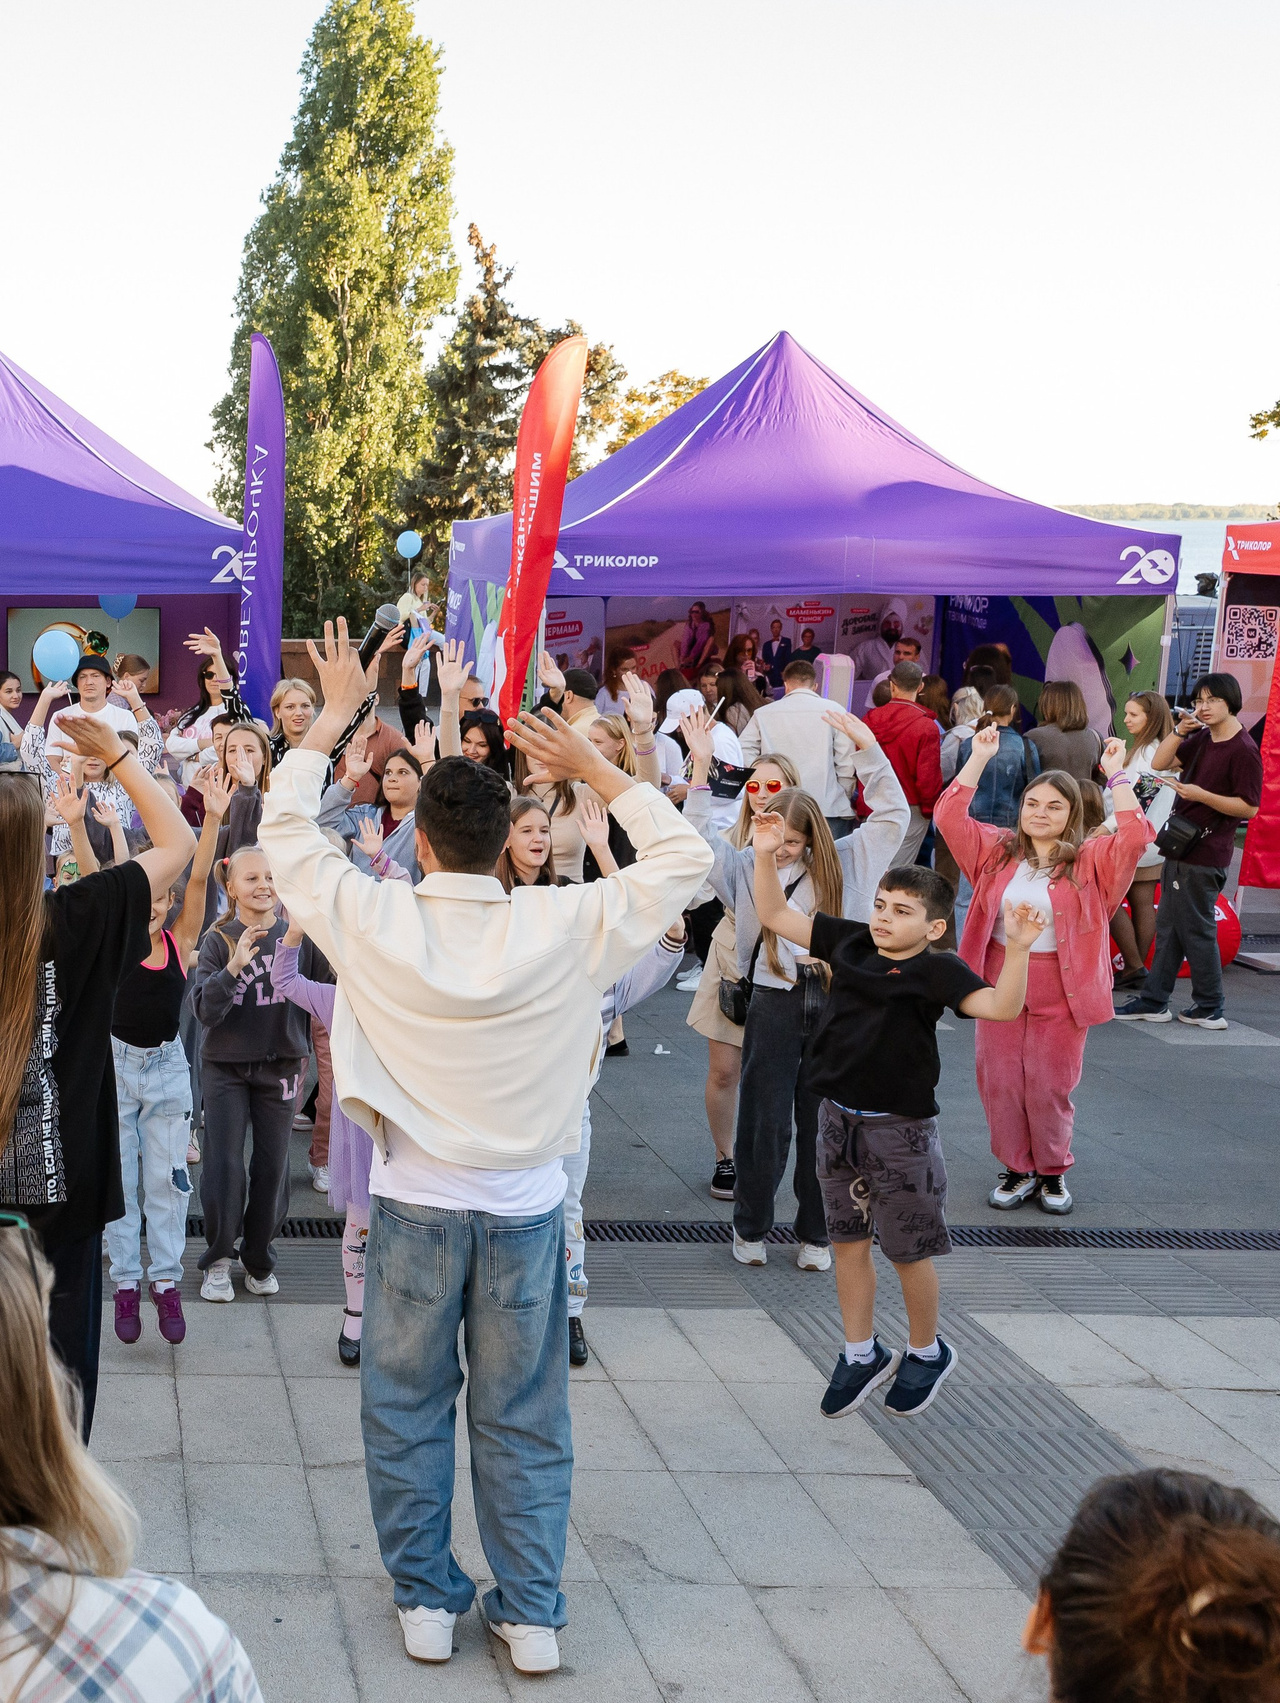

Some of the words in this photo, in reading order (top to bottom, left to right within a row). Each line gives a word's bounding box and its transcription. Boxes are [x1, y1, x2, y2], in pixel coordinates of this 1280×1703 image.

[1236, 540, 1272, 551] ТРИКОЛОР
[573, 555, 659, 568] ТРИКОЛОР
[45, 959, 57, 1005] ПАНДА
[43, 1005, 55, 1022] НЕ
[42, 1023, 52, 1060] ЕСЛИ
[42, 1121, 52, 1139] НЕ
[43, 1140, 56, 1175] ЕСЛИ
[46, 1175, 58, 1204] КТО,
